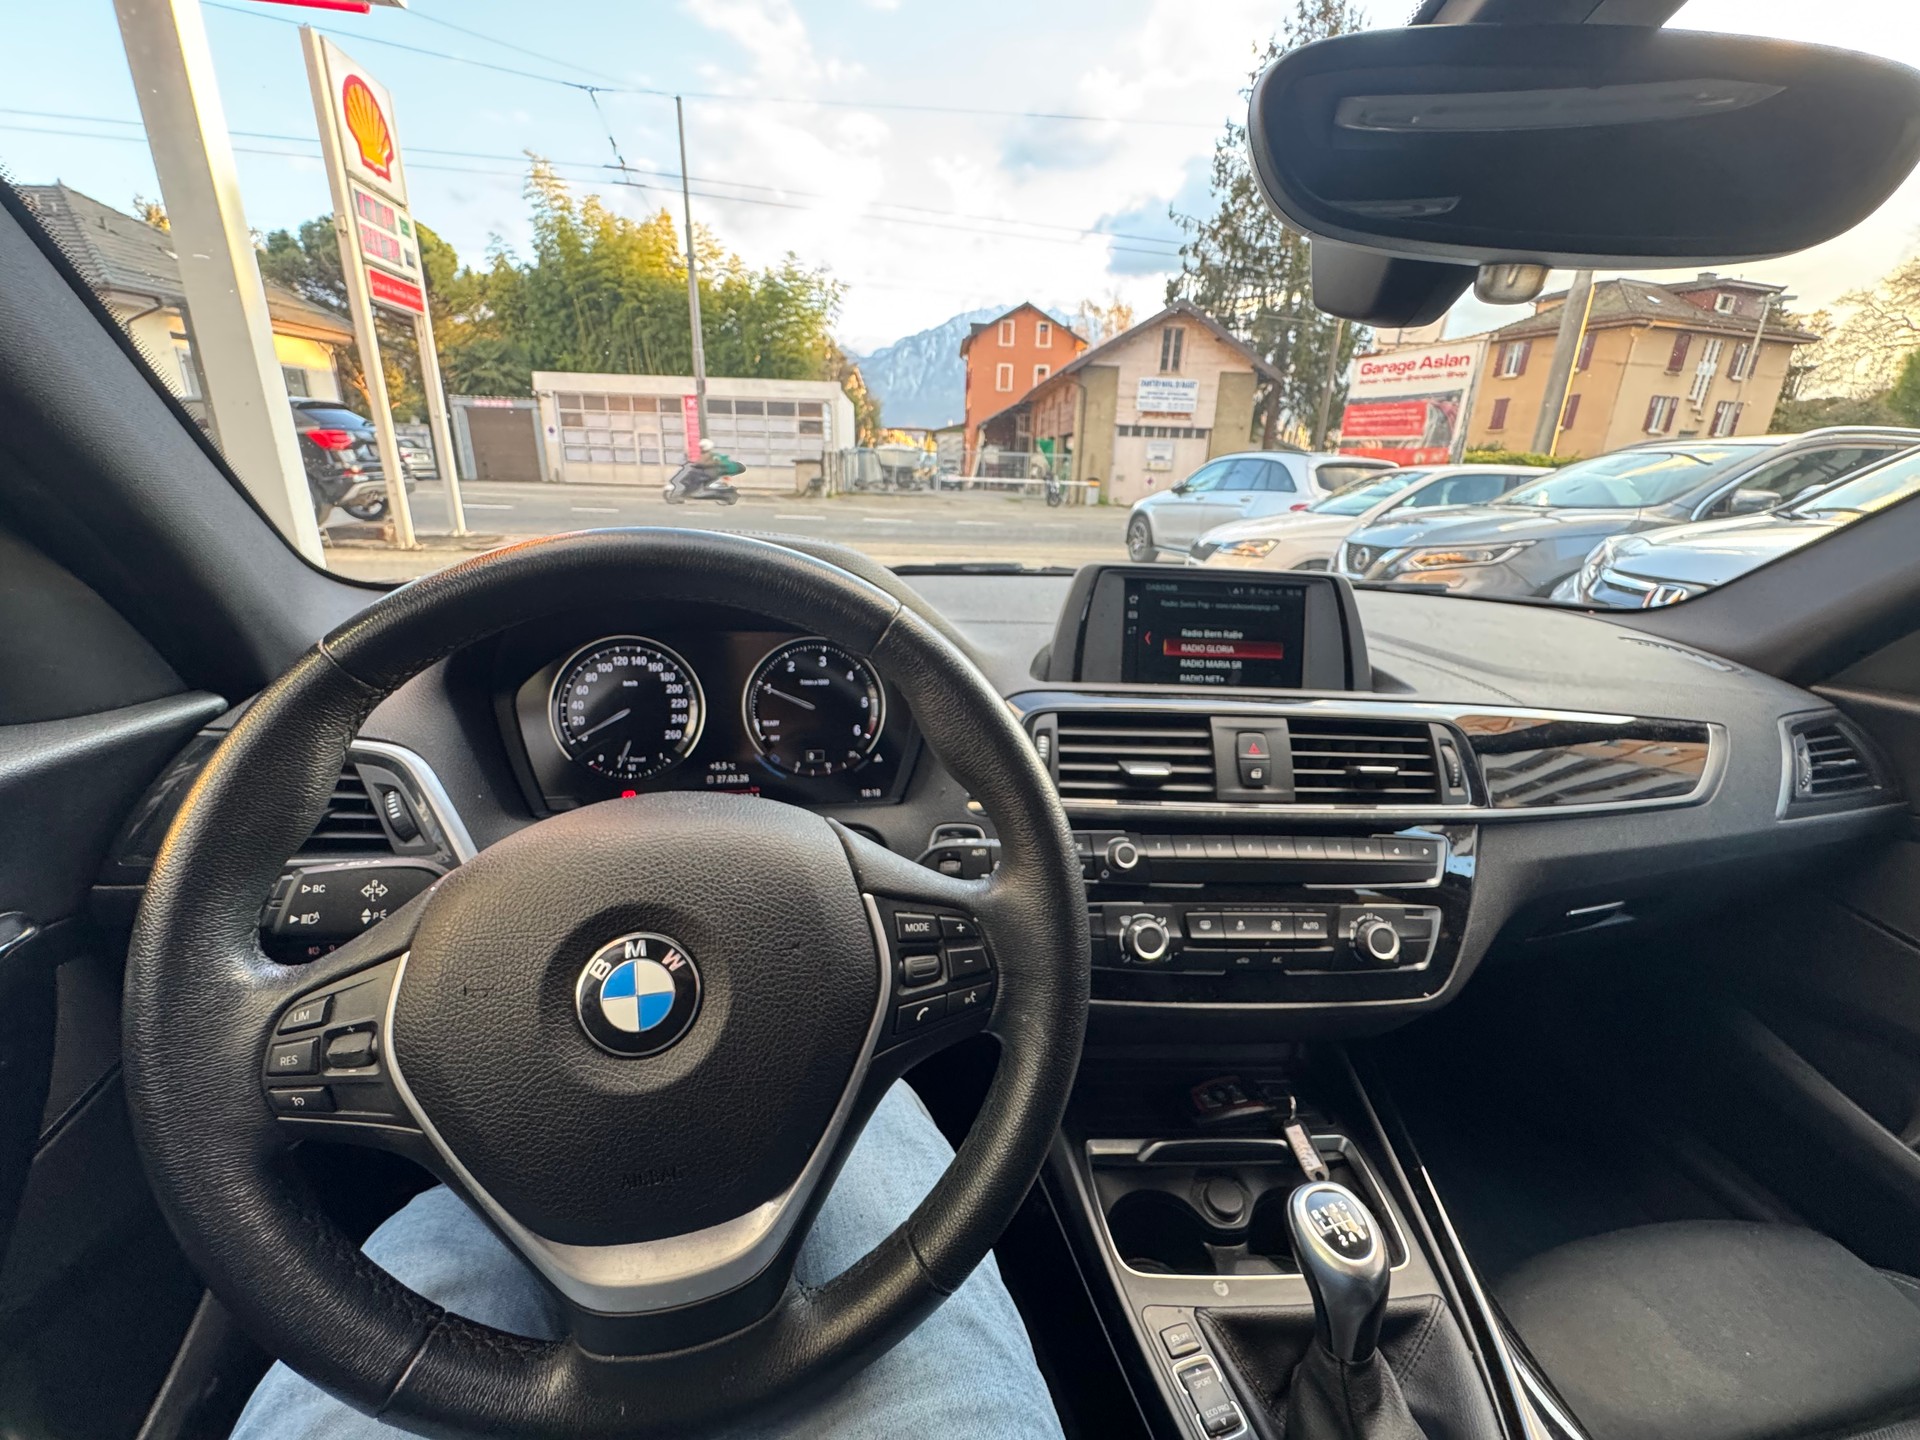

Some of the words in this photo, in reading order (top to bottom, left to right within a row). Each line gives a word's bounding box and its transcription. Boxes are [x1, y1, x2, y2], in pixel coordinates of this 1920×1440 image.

[1361, 360, 1416, 375] Garage
[1419, 354, 1470, 369] Aslan
[1181, 629, 1203, 638] Radio
[1204, 630, 1222, 639] Bern
[1180, 644, 1205, 653] RADIO
[1206, 645, 1235, 654] GLORIA
[612, 656, 628, 666] 120
[631, 656, 647, 666] 140
[819, 656, 827, 667] 3
[1180, 659, 1204, 668] RADIO
[1206, 660, 1231, 669] MARIA
[597, 662, 613, 672] 100
[648, 662, 664, 672] 160
[787, 661, 795, 672] 2
[585, 672, 598, 682] 80
[660, 672, 676, 682] 180
[846, 670, 854, 682] 4
[1179, 674, 1204, 682] RADIO
[576, 685, 589, 695] 60
[666, 685, 683, 694] 200
[571, 701, 584, 710] 40
[671, 699, 688, 709] 220
[861, 697, 868, 709] 5
[572, 716, 585, 726] 20
[671, 714, 688, 724] 240
[762, 719, 780, 727] READY
[665, 730, 682, 740] 260
[853, 724, 861, 736] 6
[372, 879, 378, 887] R
[312, 884, 326, 893] BC
[904, 922, 930, 933] MODE
[1302, 921, 1319, 930] AUTO
[589, 939, 686, 981] BMW
[293, 1010, 310, 1023] LIM
[279, 1054, 298, 1067] RES
[1311, 1209, 1321, 1220] R
[1338, 1200, 1347, 1210] 5
[1338, 1234, 1349, 1246] 2
[1193, 1376, 1212, 1389] SPORT
[1205, 1408, 1217, 1418] ECO
[1217, 1403, 1229, 1414] PRO
